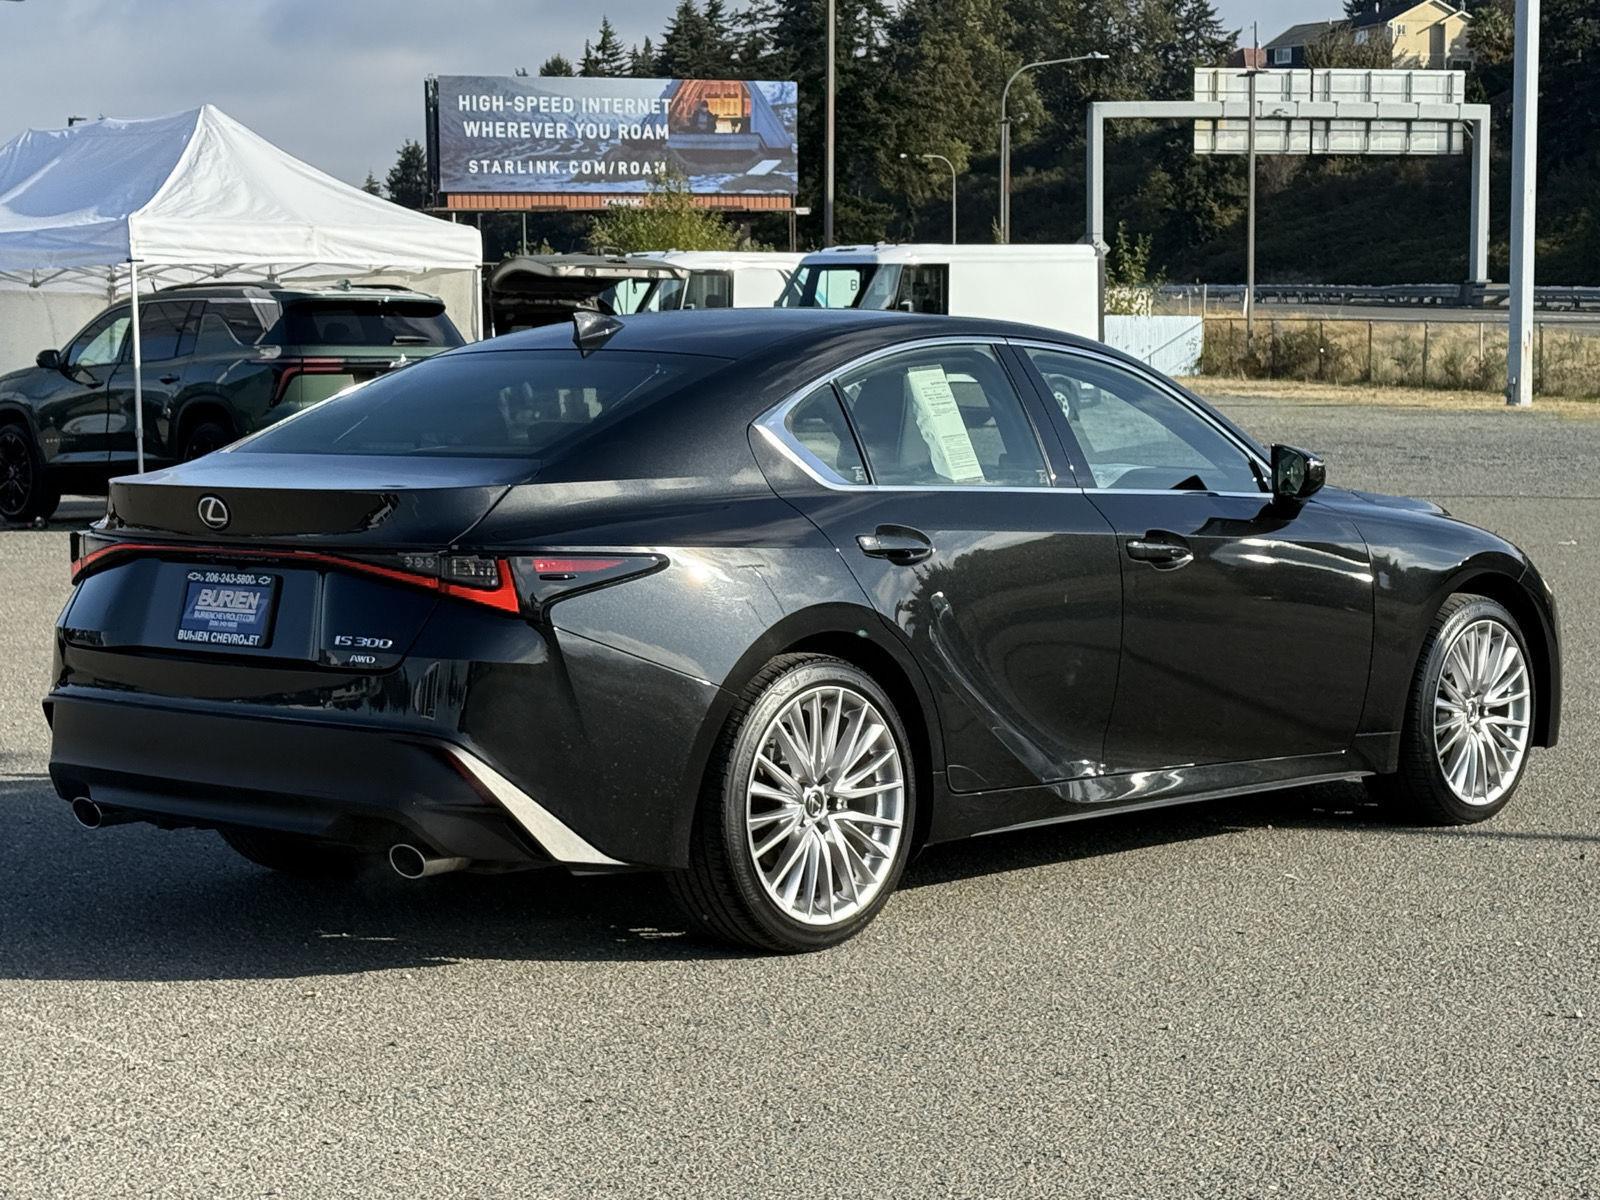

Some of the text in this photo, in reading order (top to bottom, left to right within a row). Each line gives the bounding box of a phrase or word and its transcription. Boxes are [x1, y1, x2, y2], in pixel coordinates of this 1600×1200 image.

[457, 94, 673, 115] HIGH-SPEED INTERNET
[462, 120, 670, 141] WHEREVER YOU ROAM
[197, 588, 260, 609] BURIEN
[334, 635, 393, 649] IS 300
[349, 654, 376, 664] AWD
